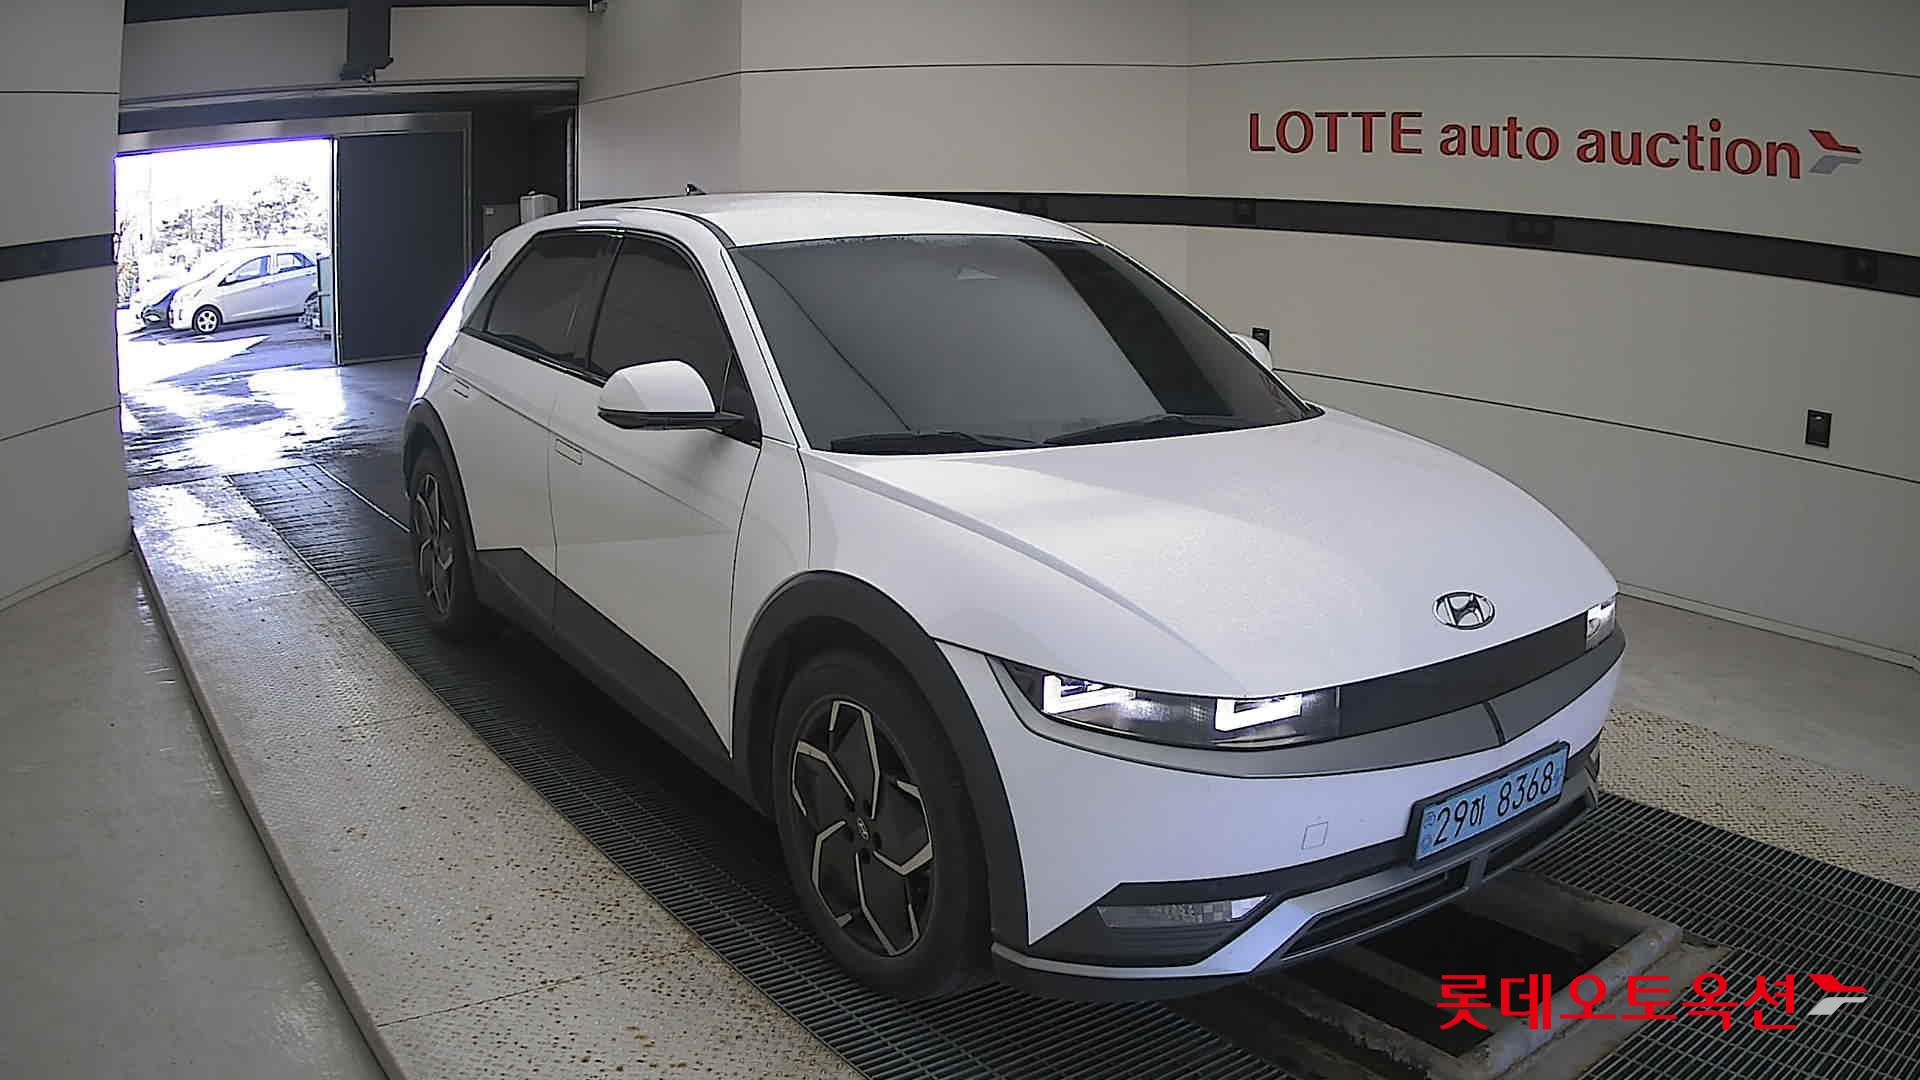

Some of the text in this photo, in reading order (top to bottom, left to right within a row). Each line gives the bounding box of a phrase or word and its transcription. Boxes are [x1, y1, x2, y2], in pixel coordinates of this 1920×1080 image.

[1249, 111, 1801, 179] LOTTE auto auction
[1497, 760, 1554, 817] 8368
